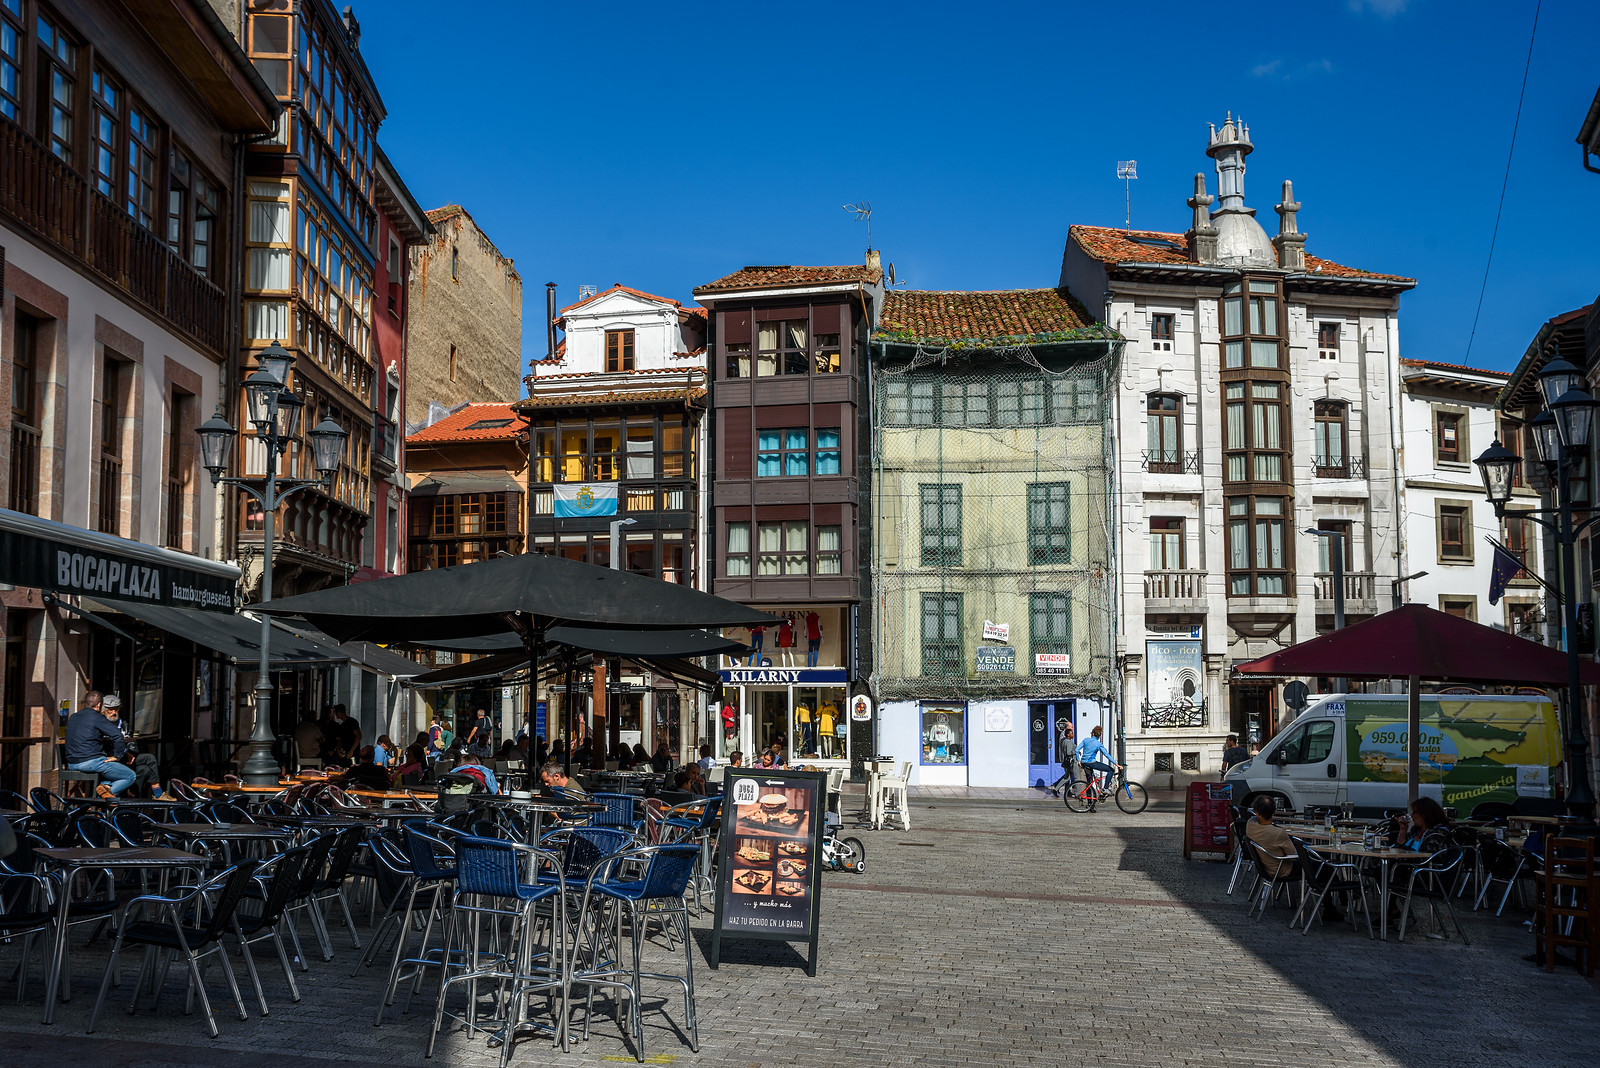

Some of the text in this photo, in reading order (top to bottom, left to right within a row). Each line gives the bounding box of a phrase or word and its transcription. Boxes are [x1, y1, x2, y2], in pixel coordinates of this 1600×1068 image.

[57, 550, 160, 600] BOCAPLAZA
[172, 581, 232, 607] hamburguesería
[1151, 645, 1198, 655] rico rico
[977, 656, 1014, 664] VENDE
[729, 670, 801, 682] KILARNY
[1371, 731, 1427, 745] 959.00
[1446, 774, 1515, 804] ganadería
[728, 916, 804, 929] HAZ TU PEDIDO EN LA BARRA
